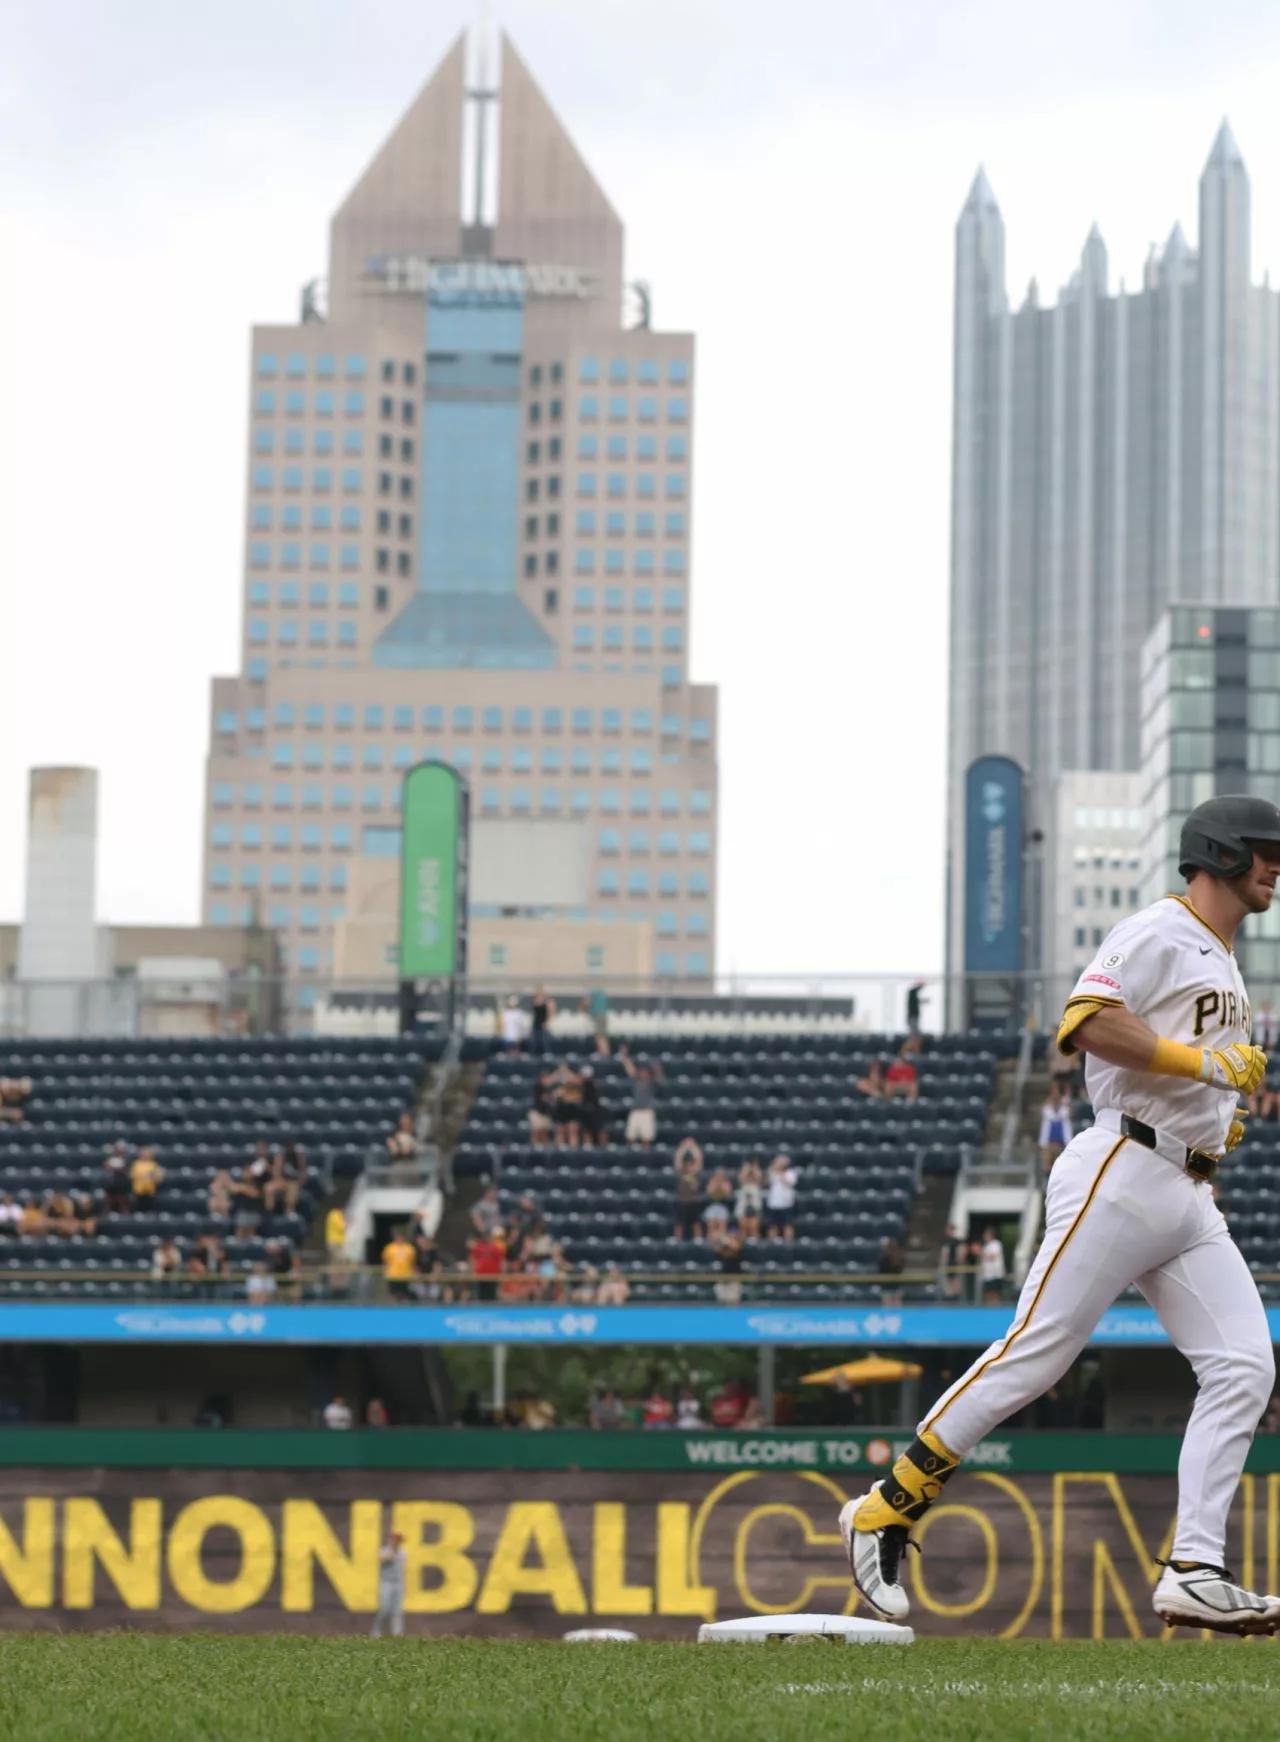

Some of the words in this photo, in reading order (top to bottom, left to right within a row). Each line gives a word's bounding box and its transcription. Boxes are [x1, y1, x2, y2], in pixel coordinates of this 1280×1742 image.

[1106, 955, 1120, 967] 9
[685, 1441, 819, 1464] WELCOME
[823, 1441, 860, 1464] TO
[961, 1441, 1013, 1464] ARK
